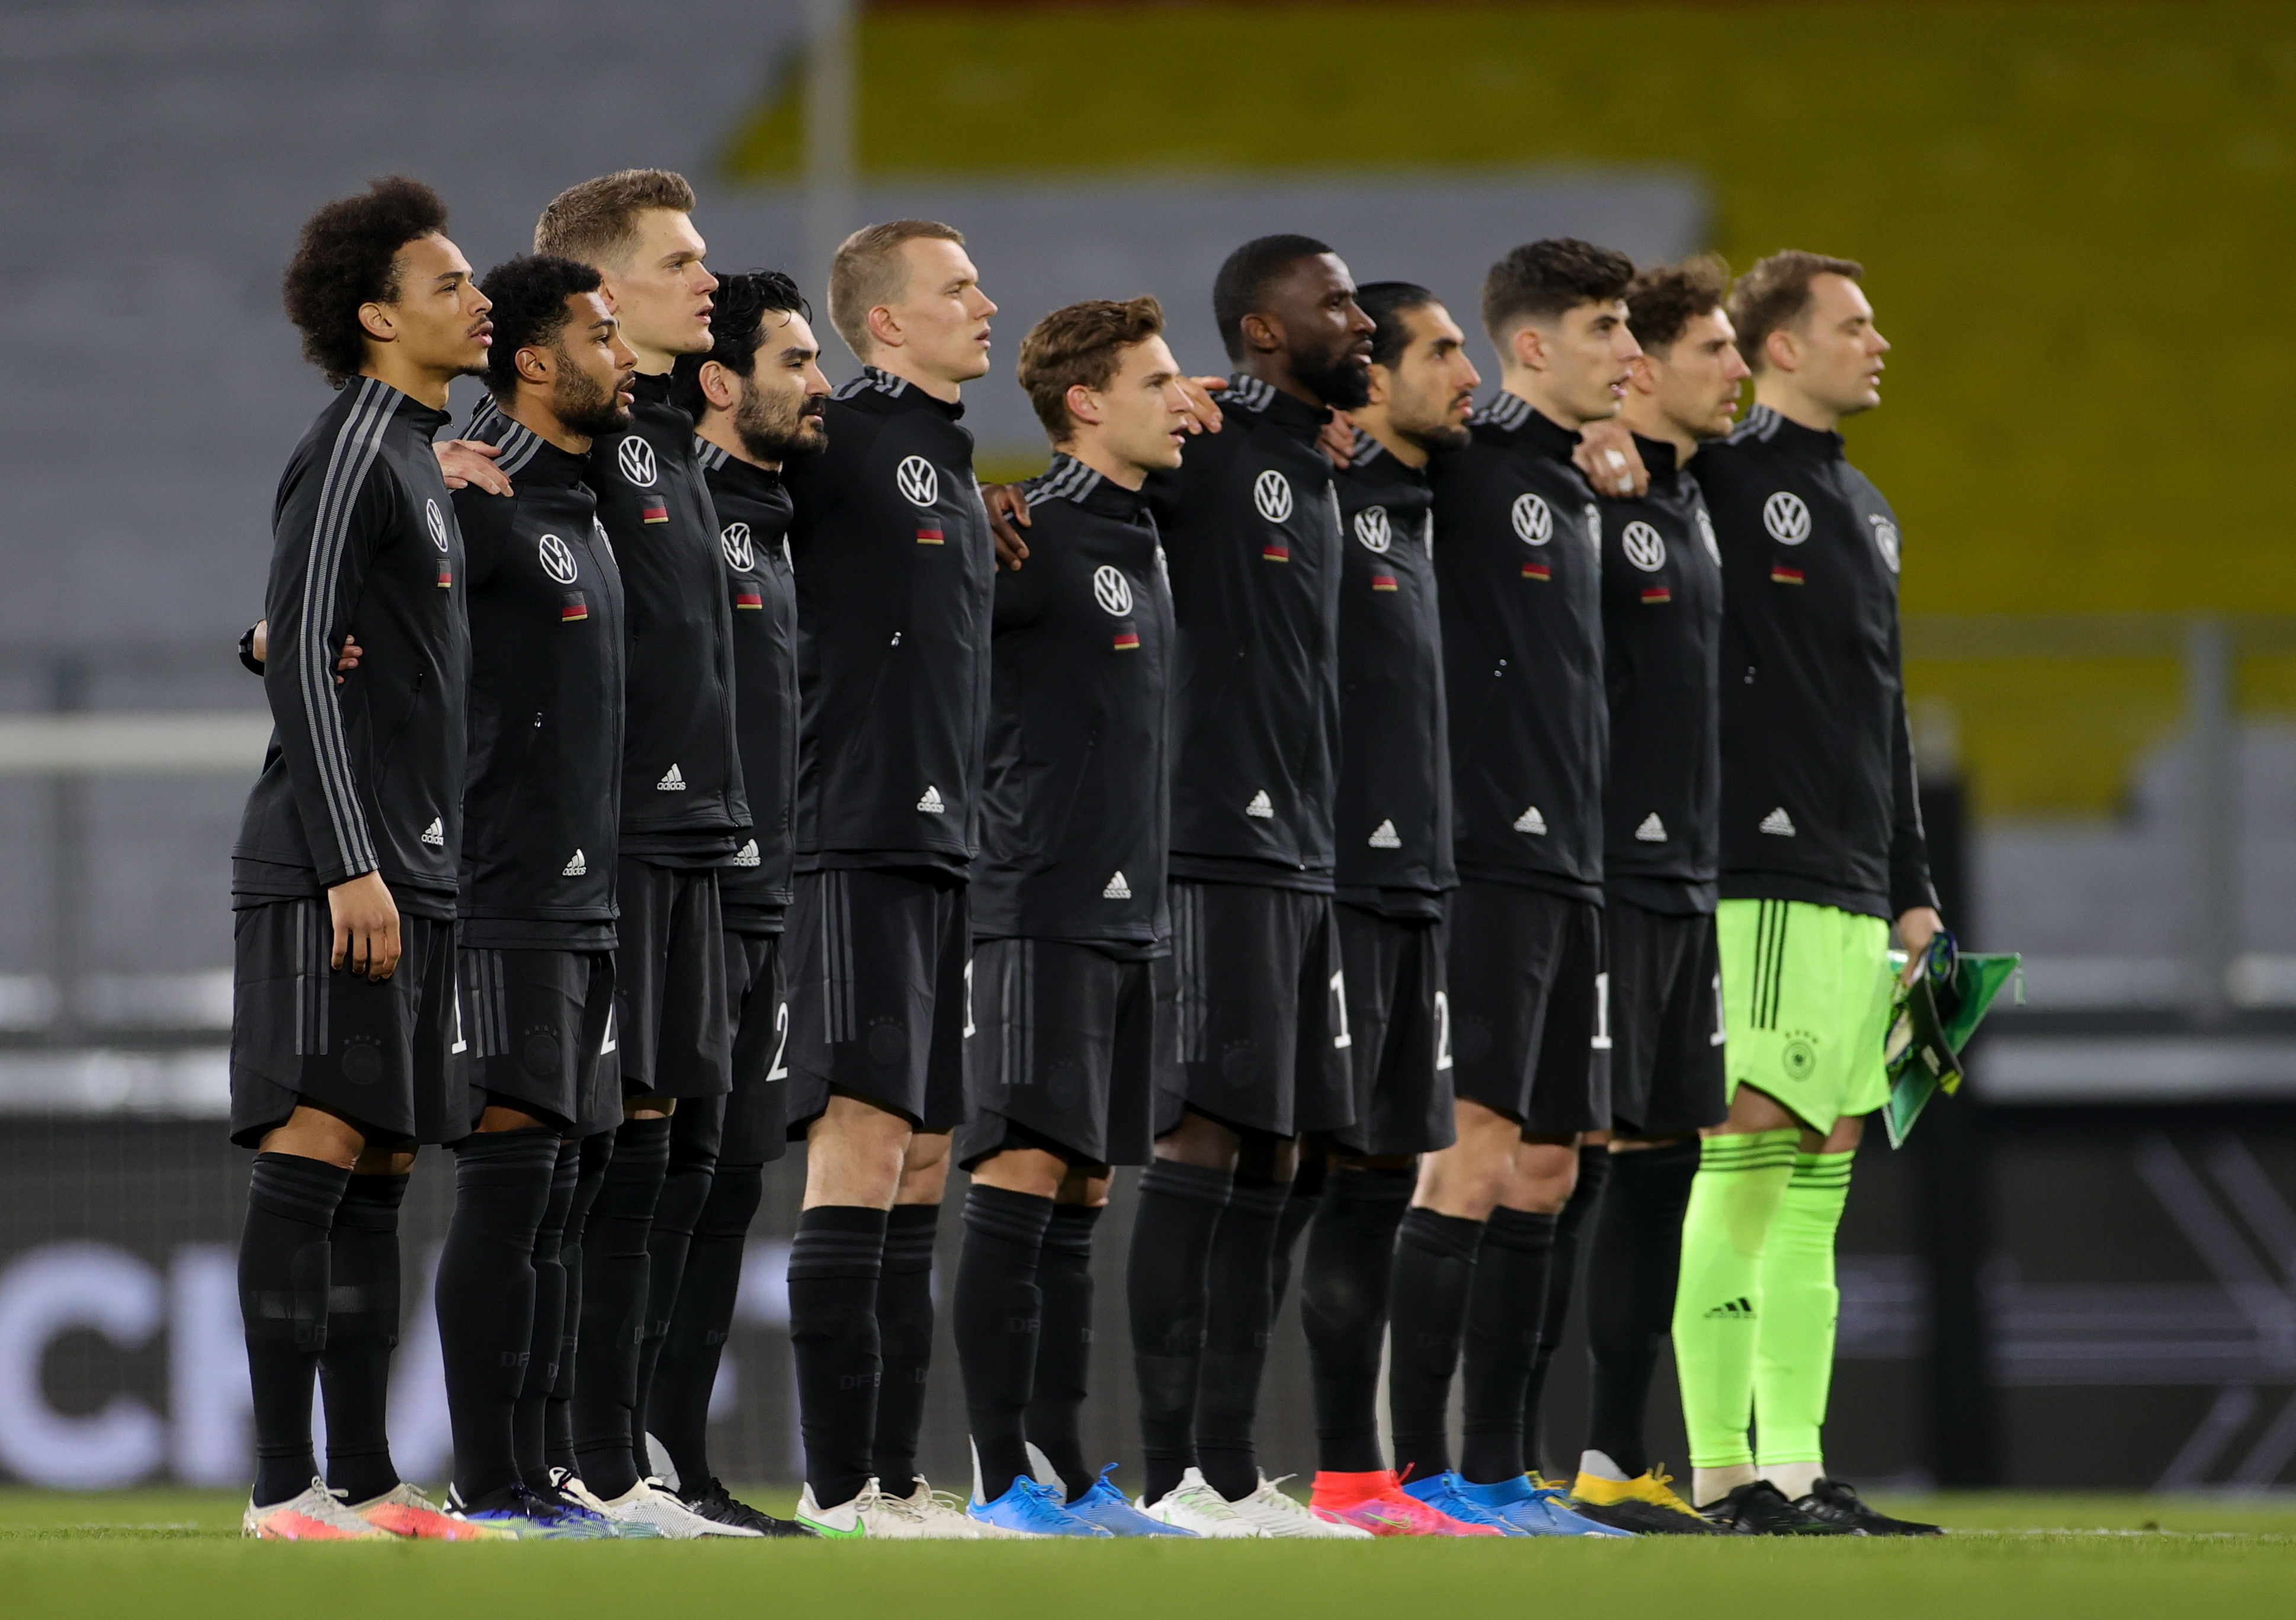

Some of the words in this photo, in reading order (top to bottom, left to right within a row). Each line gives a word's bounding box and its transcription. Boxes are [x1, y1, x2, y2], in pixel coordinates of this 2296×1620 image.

[657, 779, 686, 791] adidas
[421, 833, 444, 846] adidas
[733, 855, 761, 867] adidas
[562, 865, 587, 876] adidas
[963, 959, 976, 1038] 1
[1330, 969, 1351, 1048] 1
[1591, 973, 1612, 1050] 1
[766, 1002, 788, 1082] 2
[296, 1325, 326, 1345] DF
[500, 1351, 530, 1368] DF
